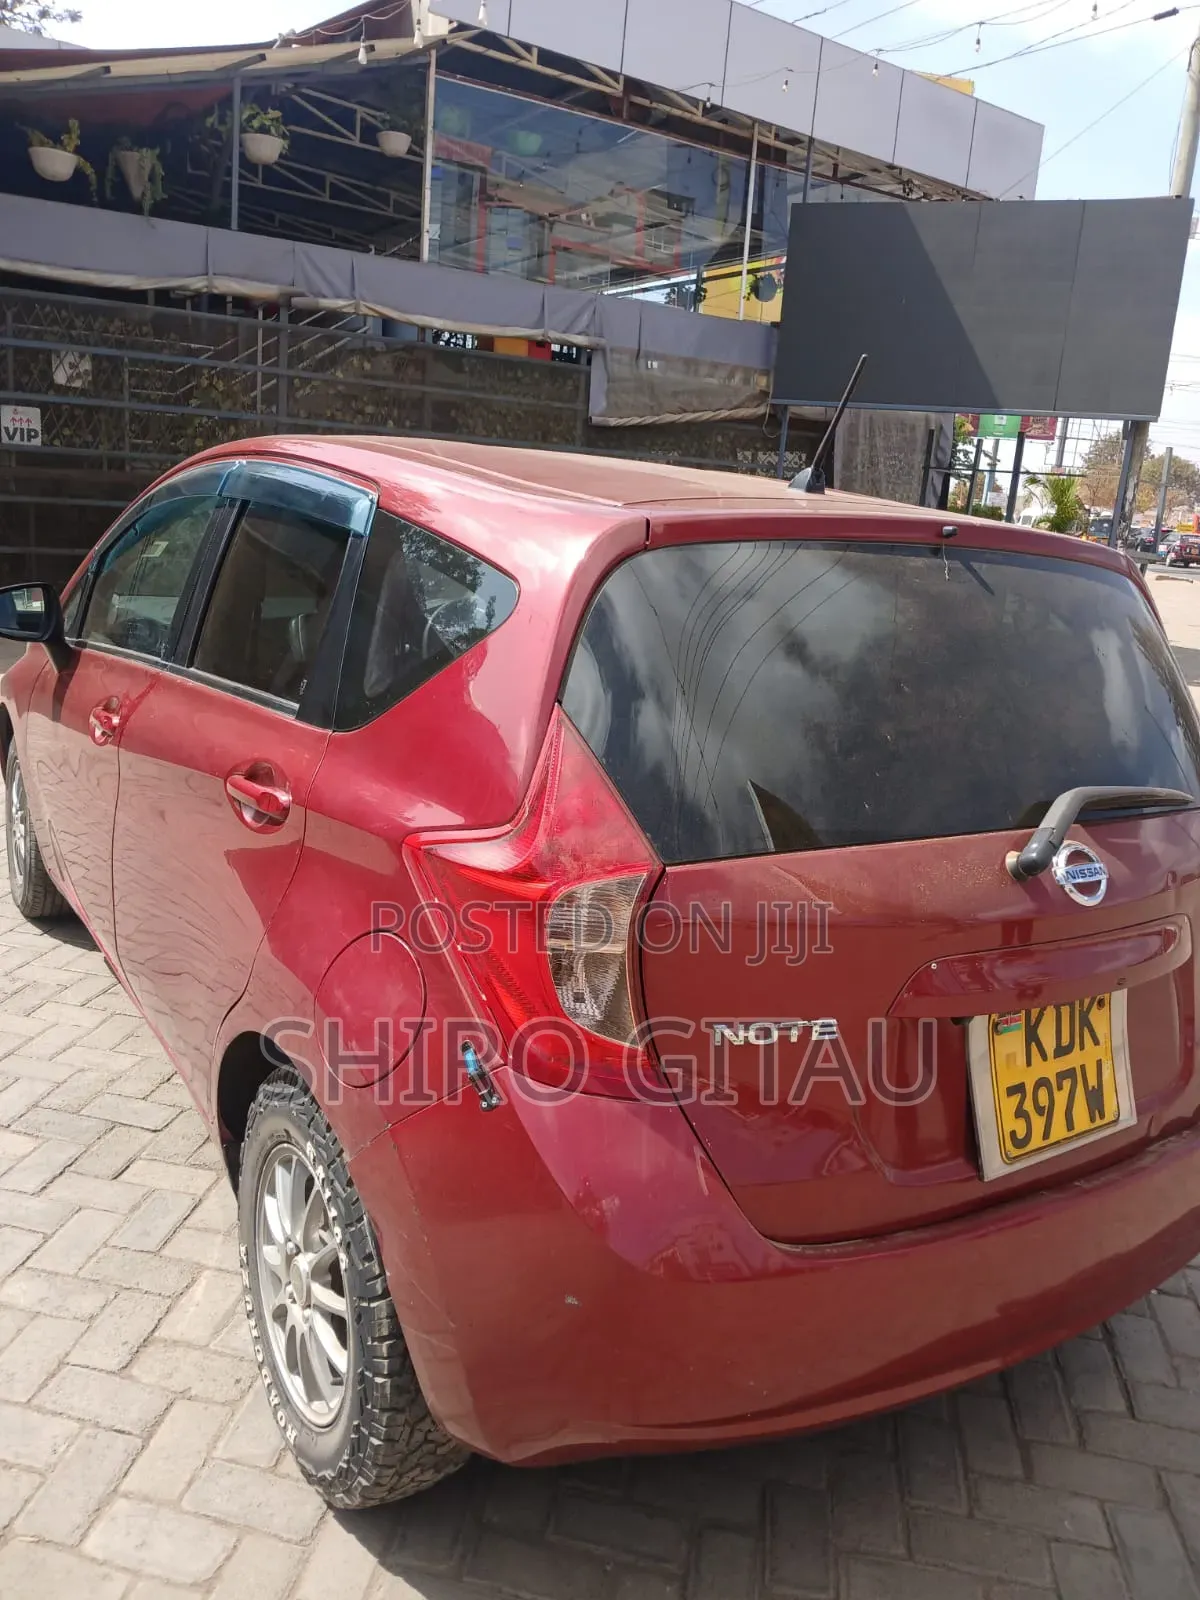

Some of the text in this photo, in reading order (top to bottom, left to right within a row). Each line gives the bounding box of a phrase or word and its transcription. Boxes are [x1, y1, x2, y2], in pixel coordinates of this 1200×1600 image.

[3, 425, 40, 443] VIP
[1065, 865, 1106, 881] NISSAN
[713, 1019, 838, 1046] NOTE
[1025, 995, 1101, 1068] KDK
[1005, 1058, 1106, 1150] 397W
